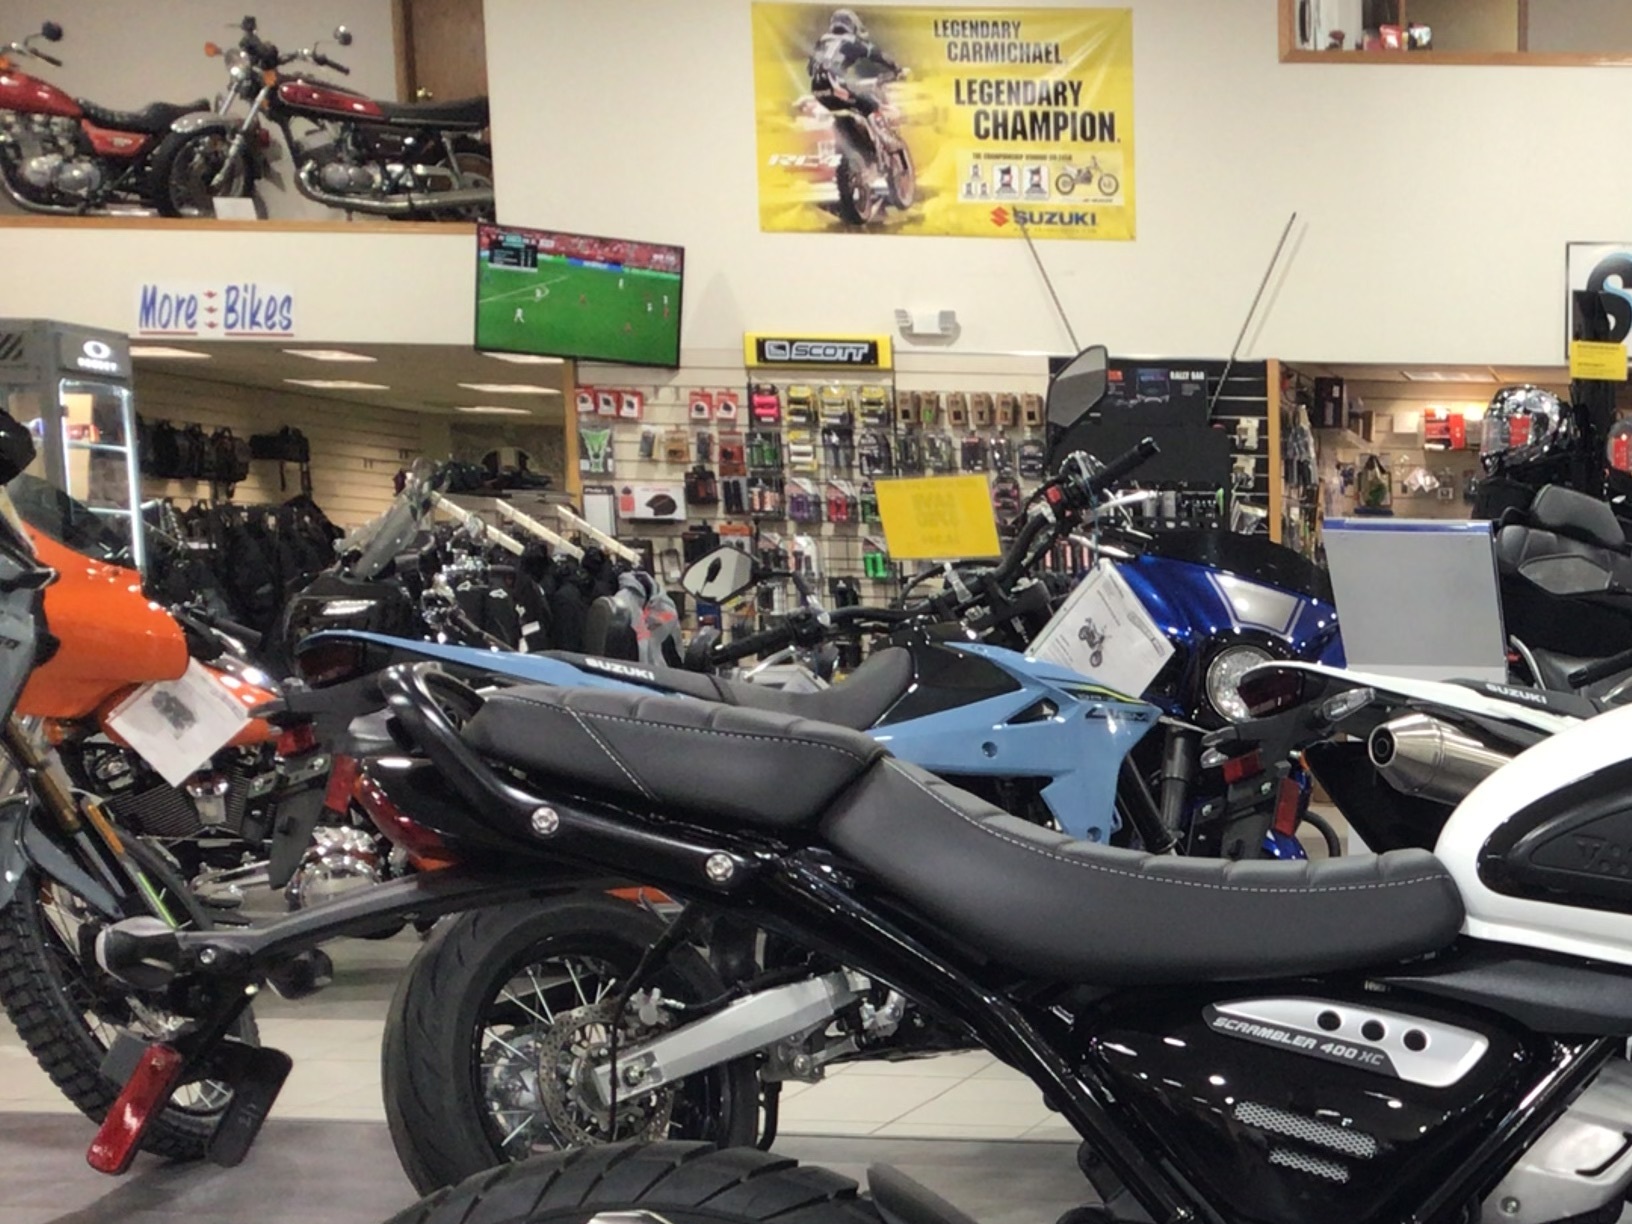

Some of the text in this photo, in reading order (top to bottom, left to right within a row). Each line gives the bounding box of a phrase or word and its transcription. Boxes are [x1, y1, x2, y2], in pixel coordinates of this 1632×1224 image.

[934, 20, 1021, 39] LEGENDARY
[954, 78, 1083, 107] LEGENDARY
[1013, 210, 1097, 227] SUZUKI
[138, 283, 293, 331] More Bikes
[792, 342, 868, 361] SCOTT
[585, 658, 655, 681] SUZUKI
[1486, 683, 1547, 704] SUZUKI
[1212, 1016, 1385, 1066] SCRAMBLER 400 XC
